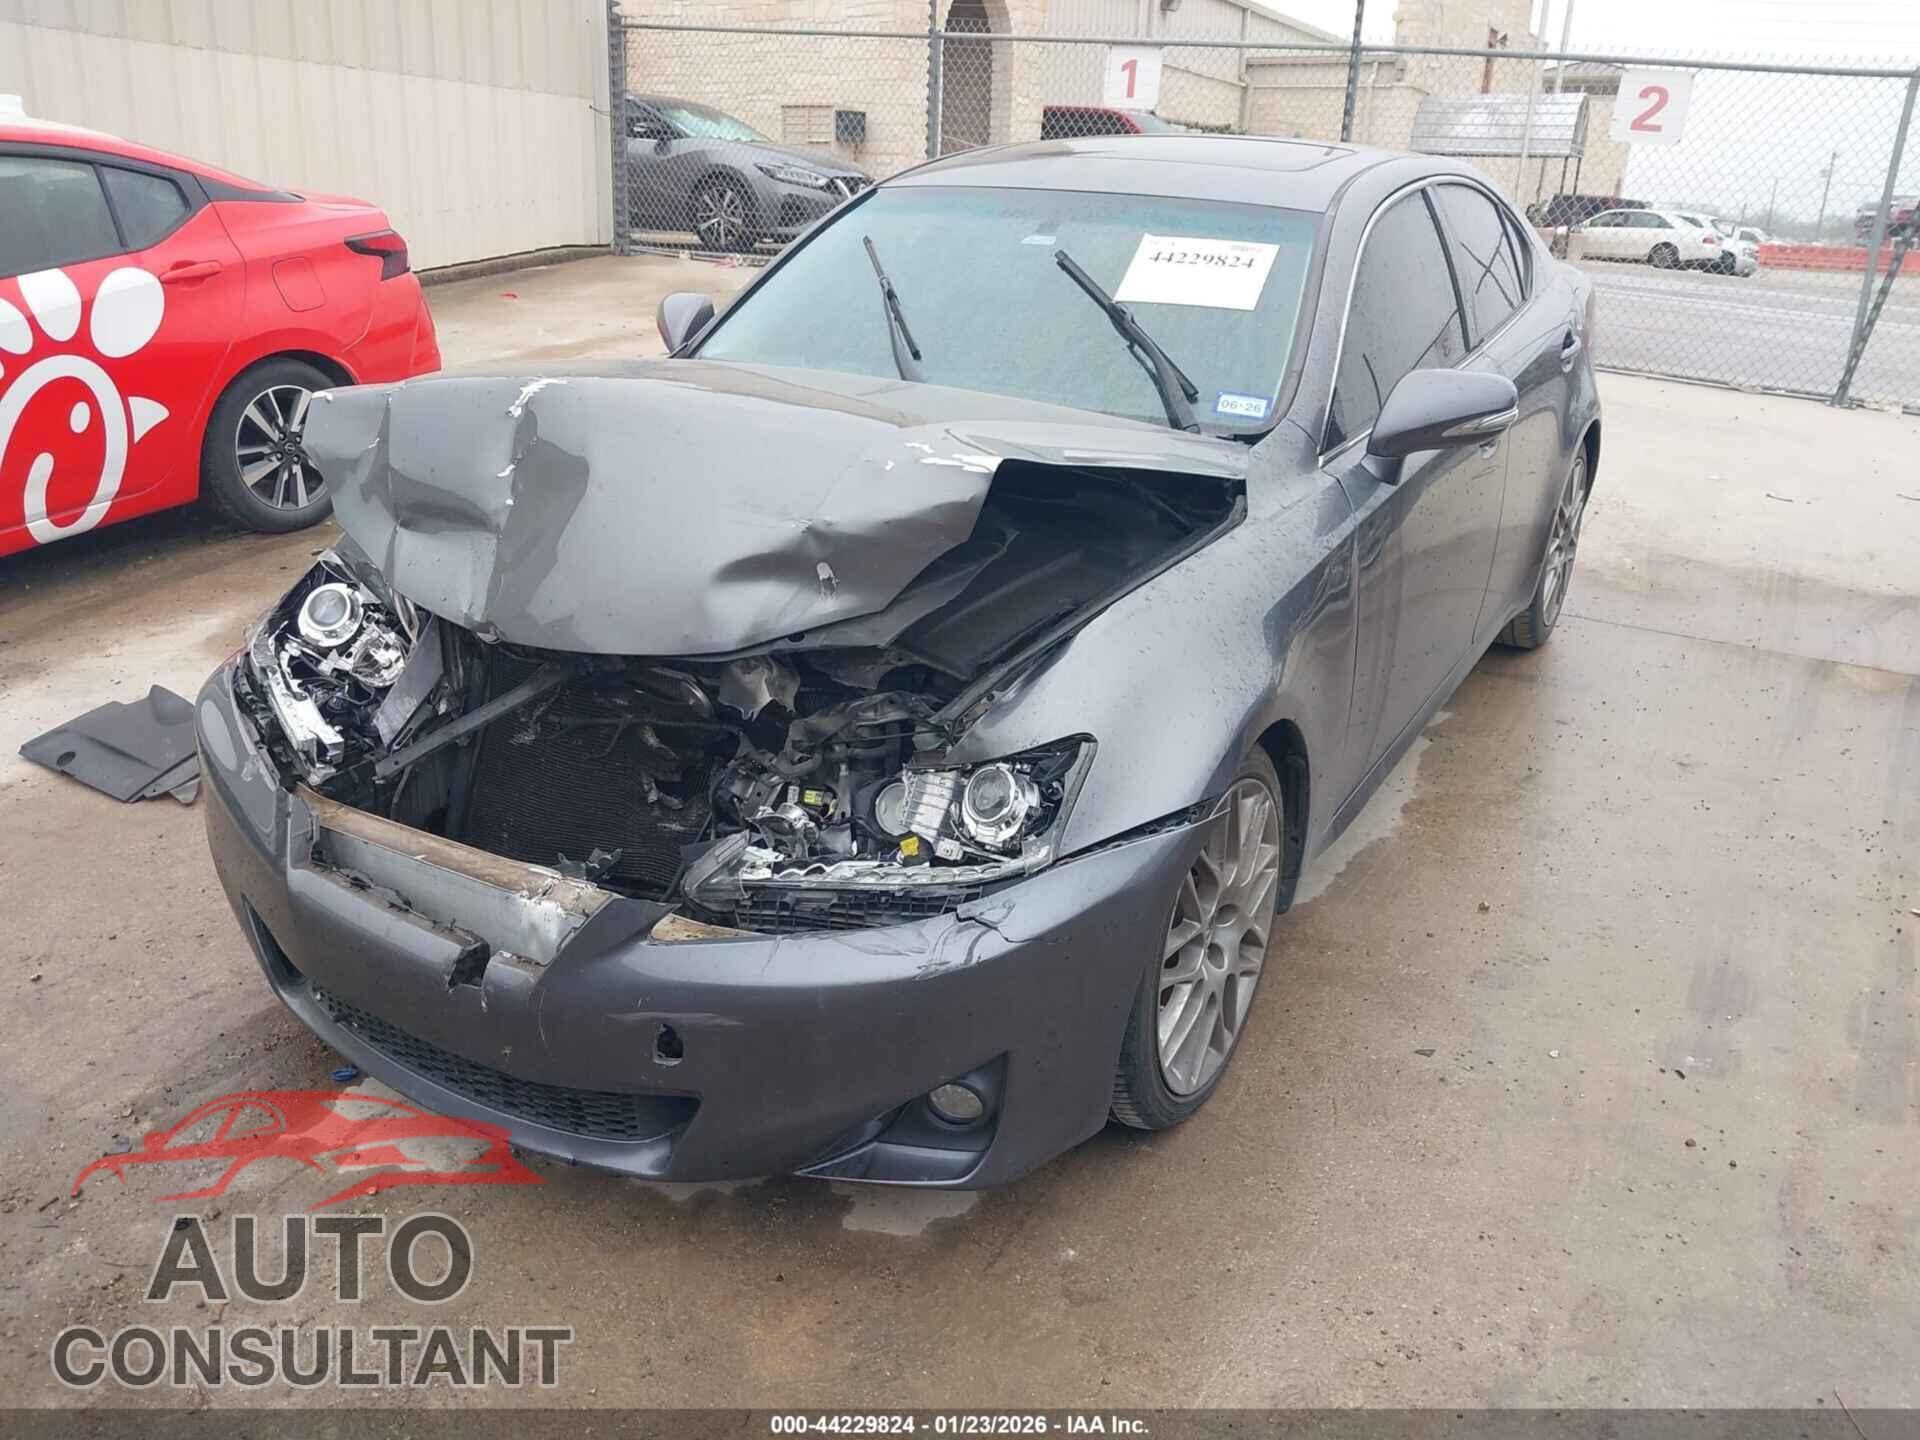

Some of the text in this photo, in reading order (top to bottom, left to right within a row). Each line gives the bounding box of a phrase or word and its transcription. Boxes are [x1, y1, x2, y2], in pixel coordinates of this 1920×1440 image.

[1121, 59, 1137, 98] 1
[1630, 86, 1669, 132] 2
[1148, 250, 1255, 269] 44229824
